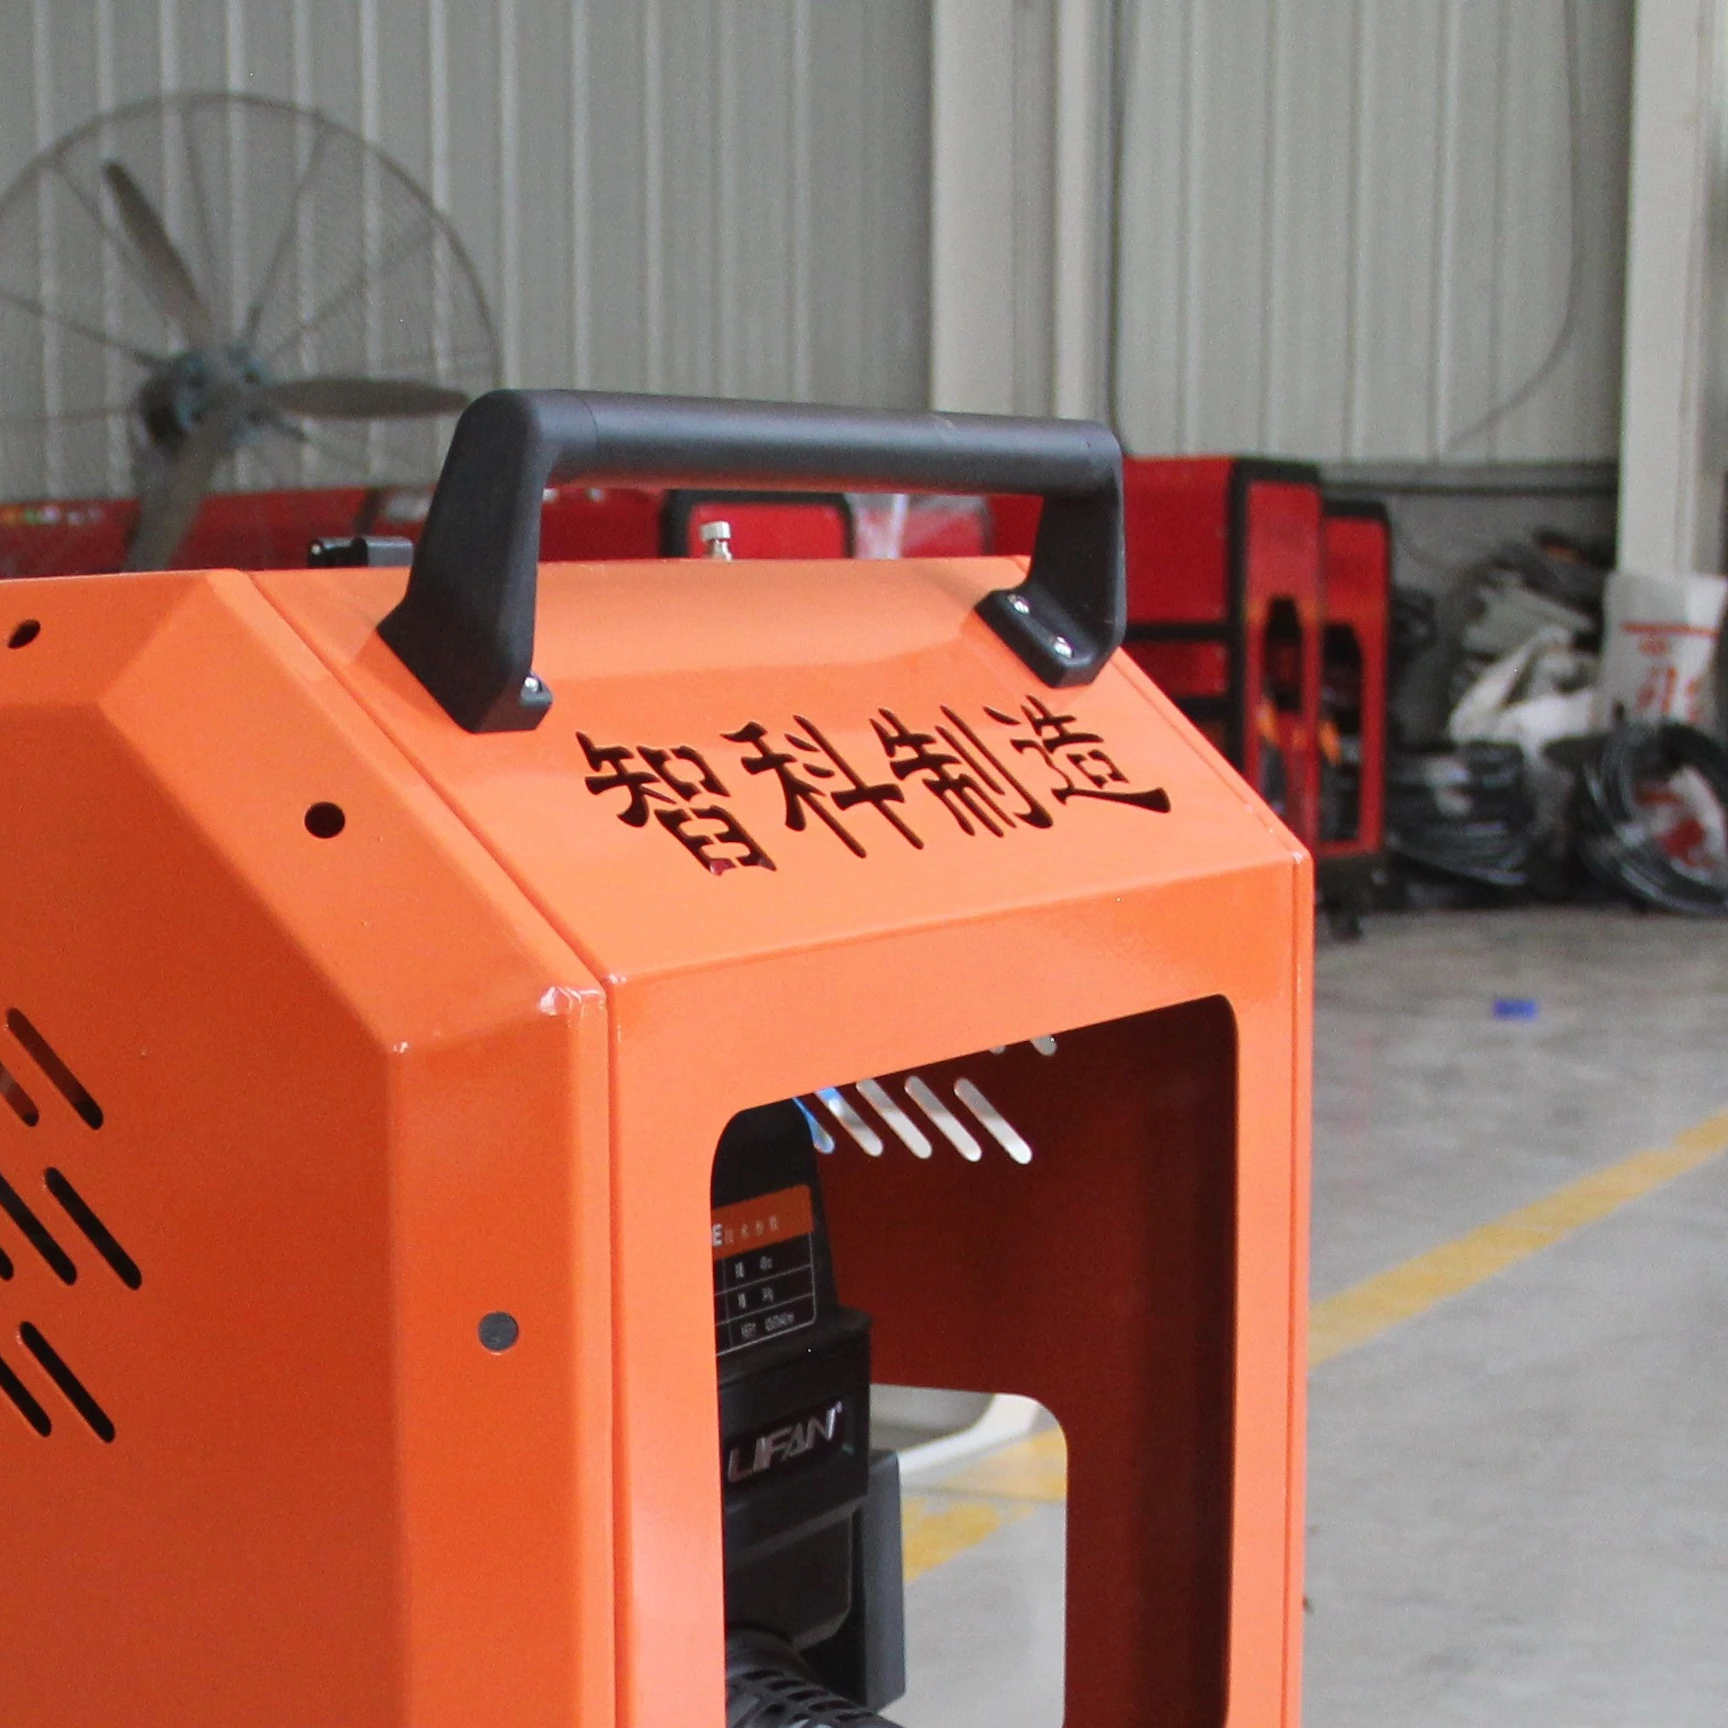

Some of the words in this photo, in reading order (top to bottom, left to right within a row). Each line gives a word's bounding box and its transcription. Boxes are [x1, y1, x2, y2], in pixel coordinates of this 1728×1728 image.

[575, 695, 1171, 875] 智科制造
[728, 1408, 837, 1482] LIFAN
